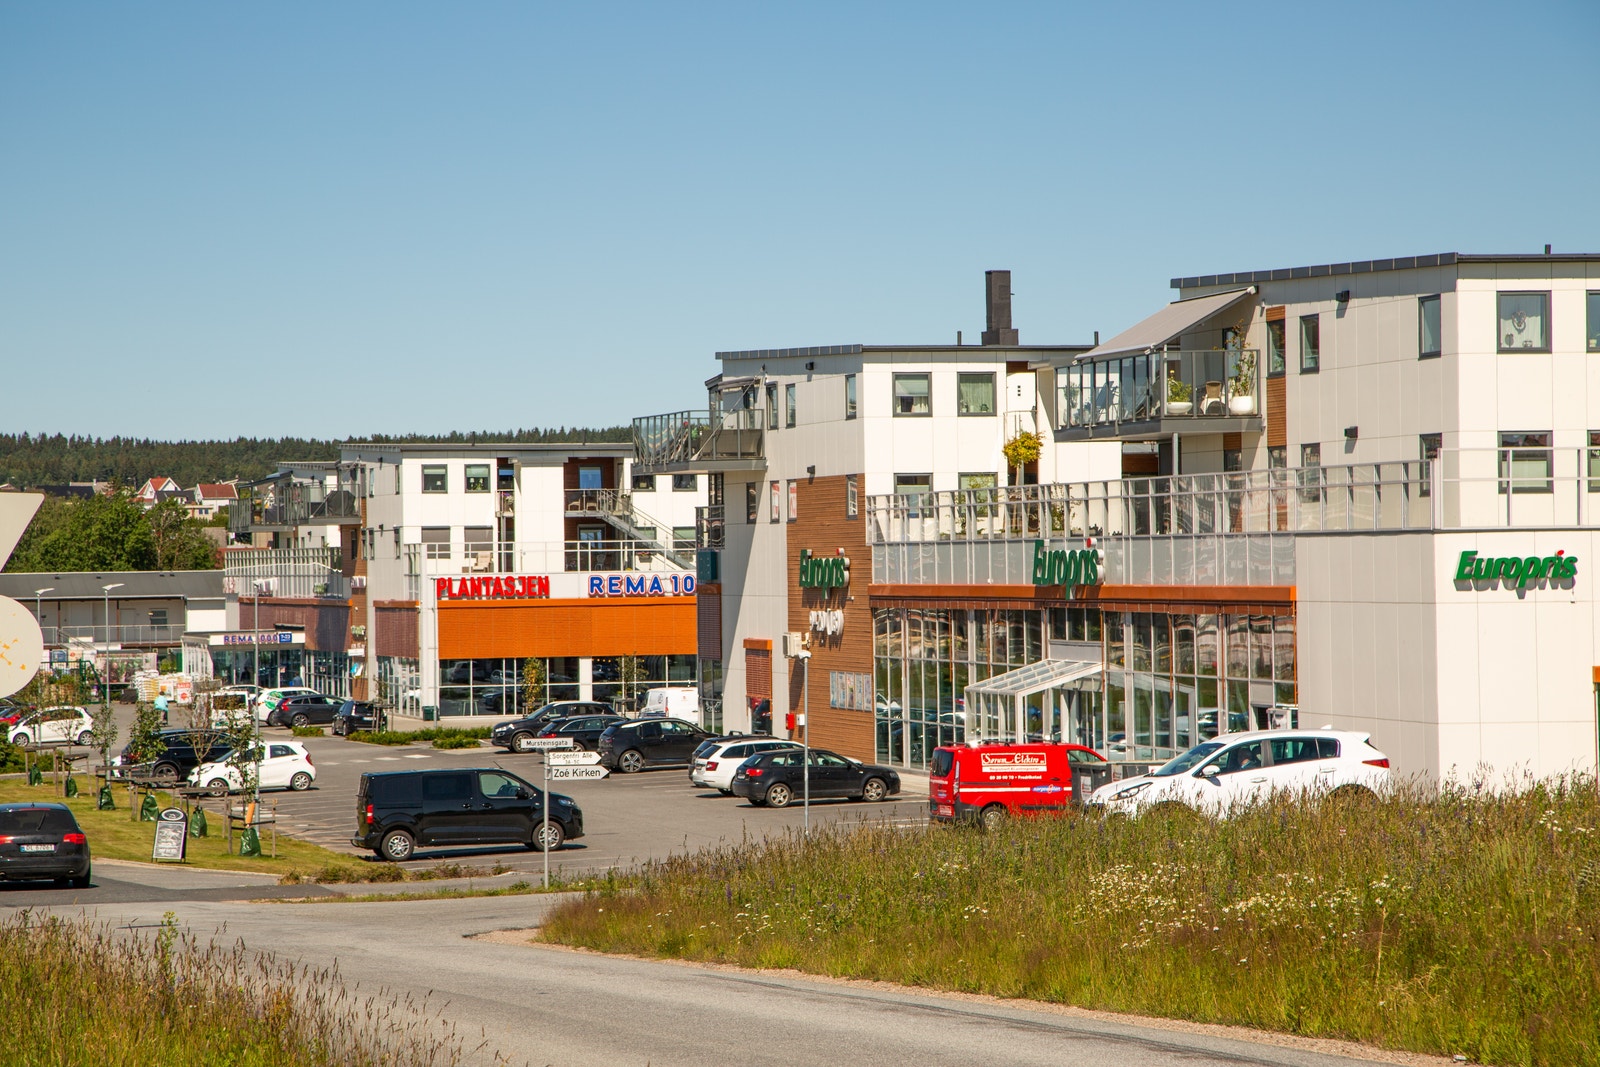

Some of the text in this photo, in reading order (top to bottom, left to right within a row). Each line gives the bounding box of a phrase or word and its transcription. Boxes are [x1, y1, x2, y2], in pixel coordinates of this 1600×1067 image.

[799, 548, 850, 600] Europris
[1032, 537, 1105, 600] Europris
[1454, 549, 1578, 589] Europris
[436, 576, 549, 598] PLANTASJEN
[588, 574, 663, 595] REMA
[223, 634, 278, 643] REMA 000
[552, 752, 580, 760] Sorgenfri
[1014, 752, 1039, 764] Elektro
[572, 768, 601, 777] Kirken
